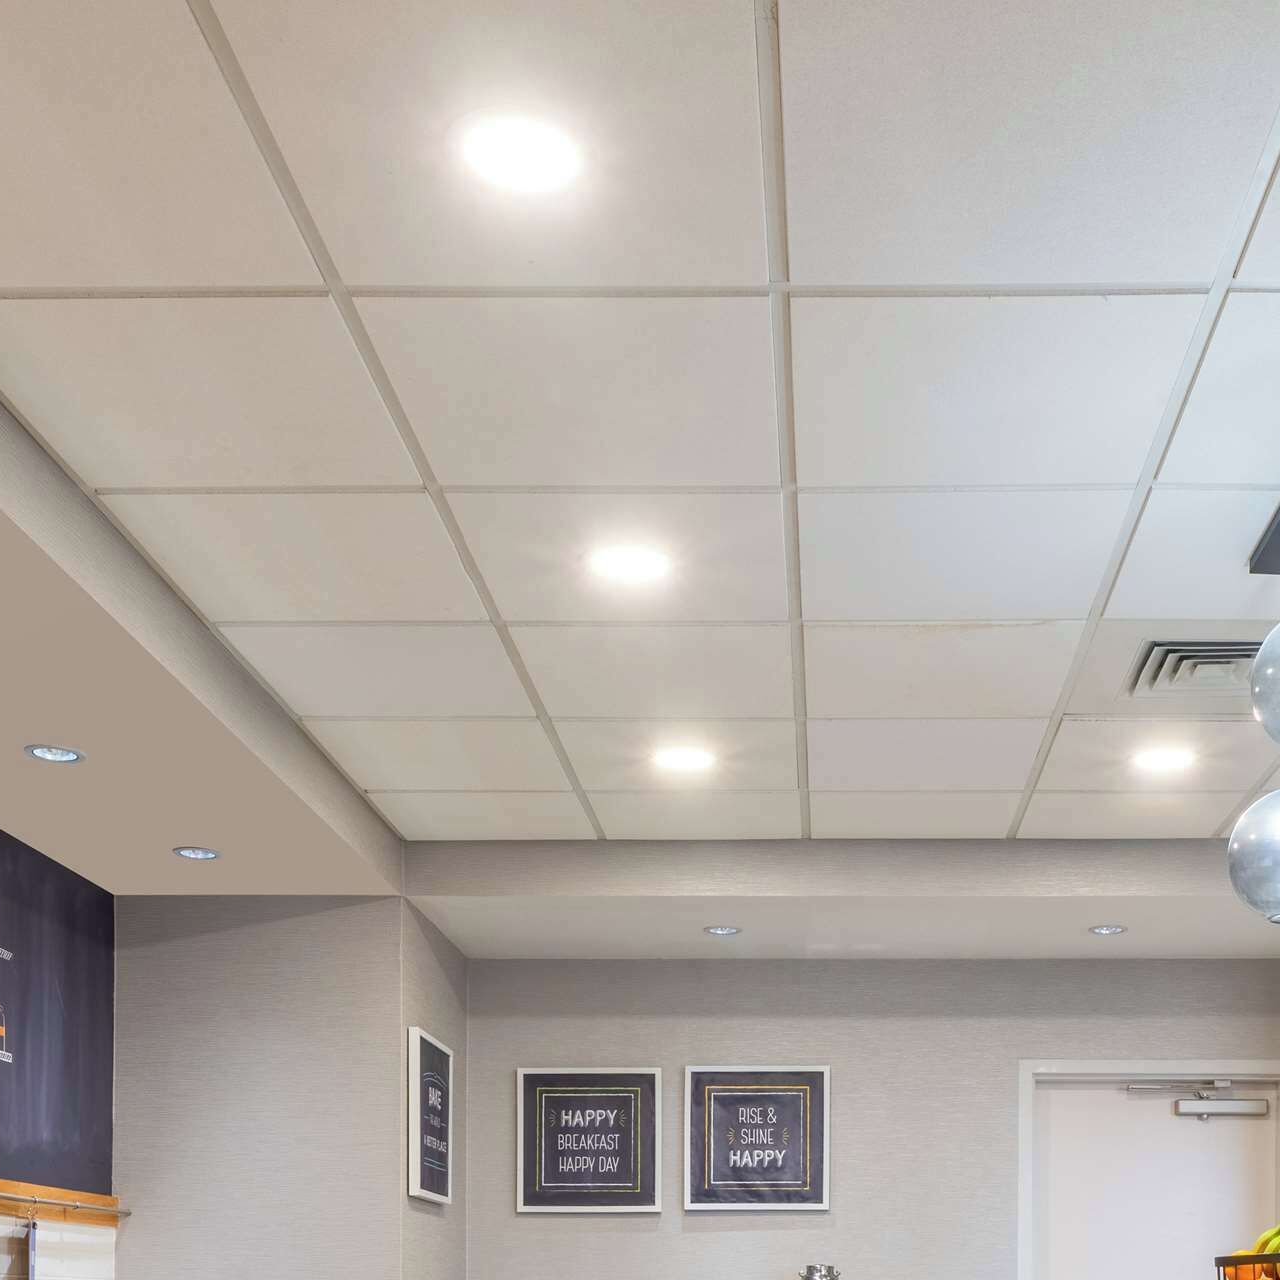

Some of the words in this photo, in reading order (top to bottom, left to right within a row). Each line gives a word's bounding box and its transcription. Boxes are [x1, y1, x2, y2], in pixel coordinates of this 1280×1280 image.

[560, 1109, 618, 1128] HAPPY
[739, 1107, 763, 1124] RISE
[767, 1107, 777, 1124] &
[558, 1134, 620, 1150] BREAKFAST
[740, 1128, 774, 1145] SHINE
[559, 1156, 596, 1173] HAPPY
[598, 1156, 620, 1173] DAY
[729, 1149, 786, 1168] HAPPY
